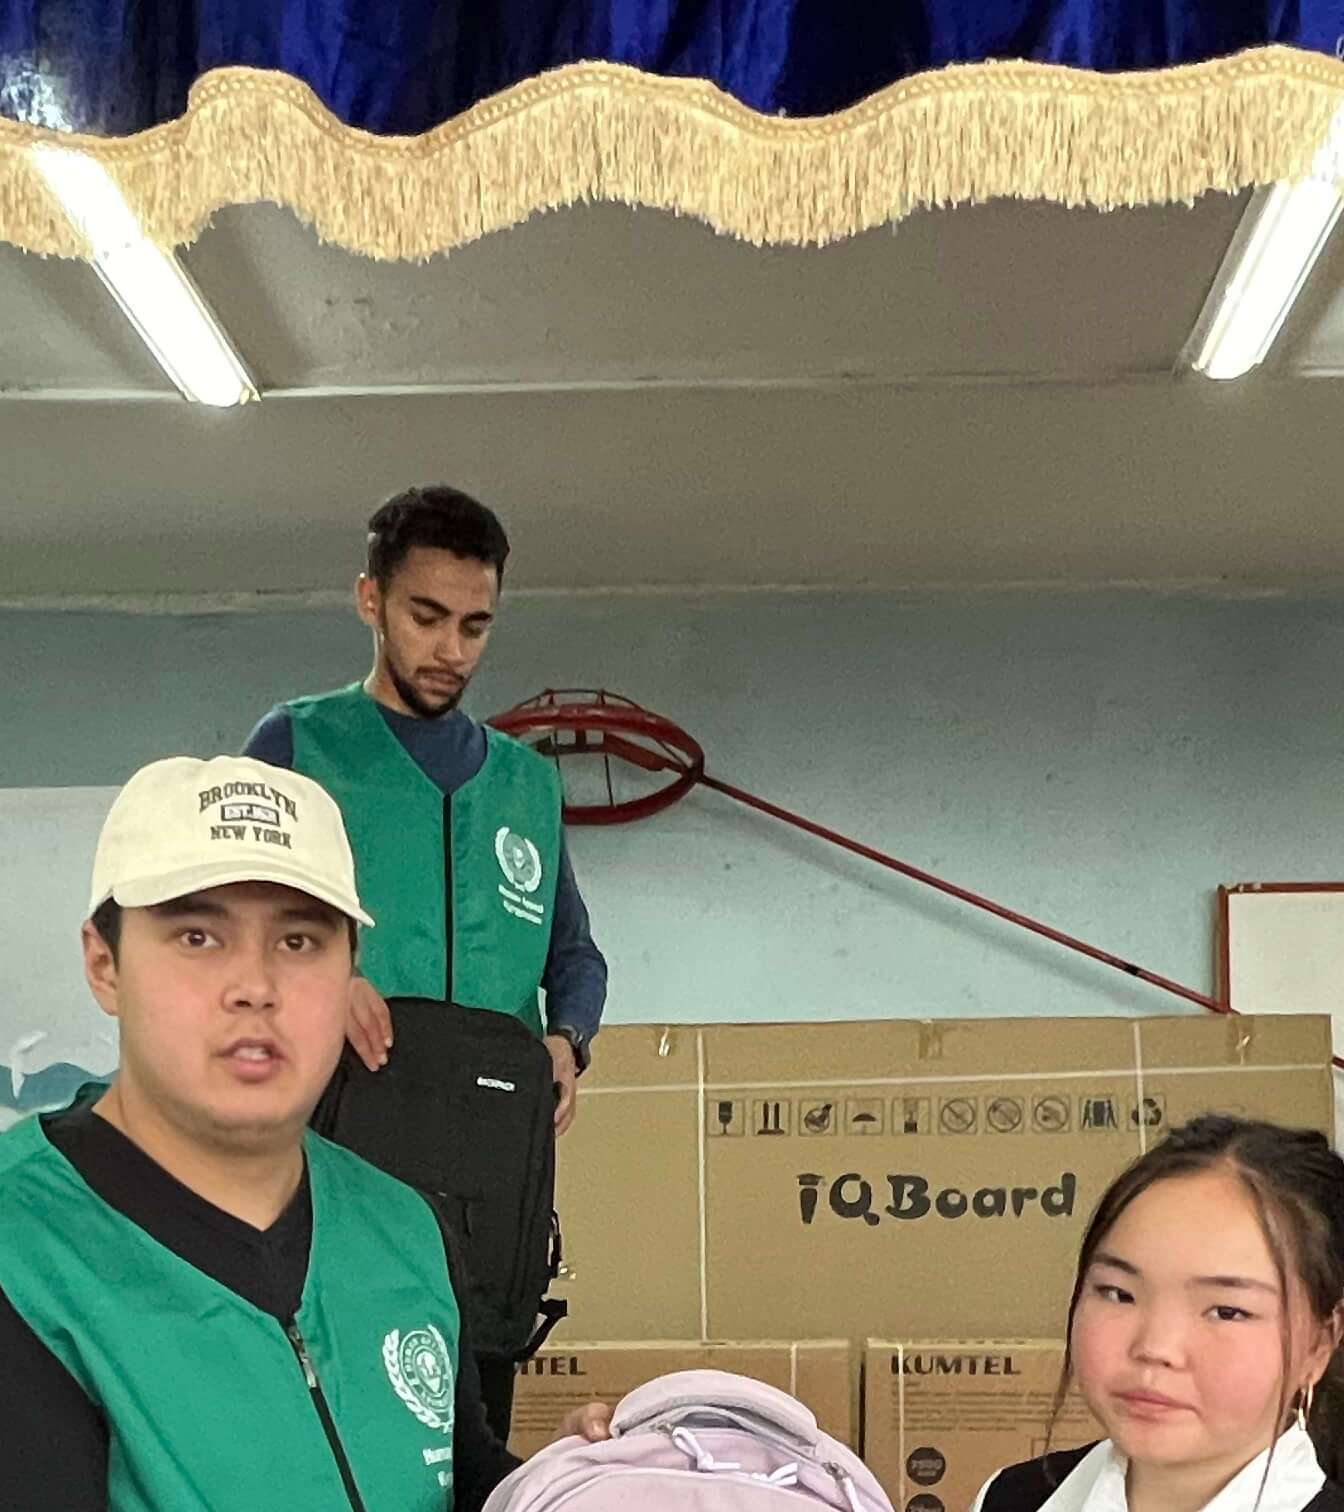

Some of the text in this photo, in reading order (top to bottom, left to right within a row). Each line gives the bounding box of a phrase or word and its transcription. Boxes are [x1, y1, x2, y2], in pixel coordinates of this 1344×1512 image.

[198, 781, 298, 823] BROOKLYN
[210, 826, 292, 849] NEW YORK
[890, 1355, 1022, 1376] KUMTEL
